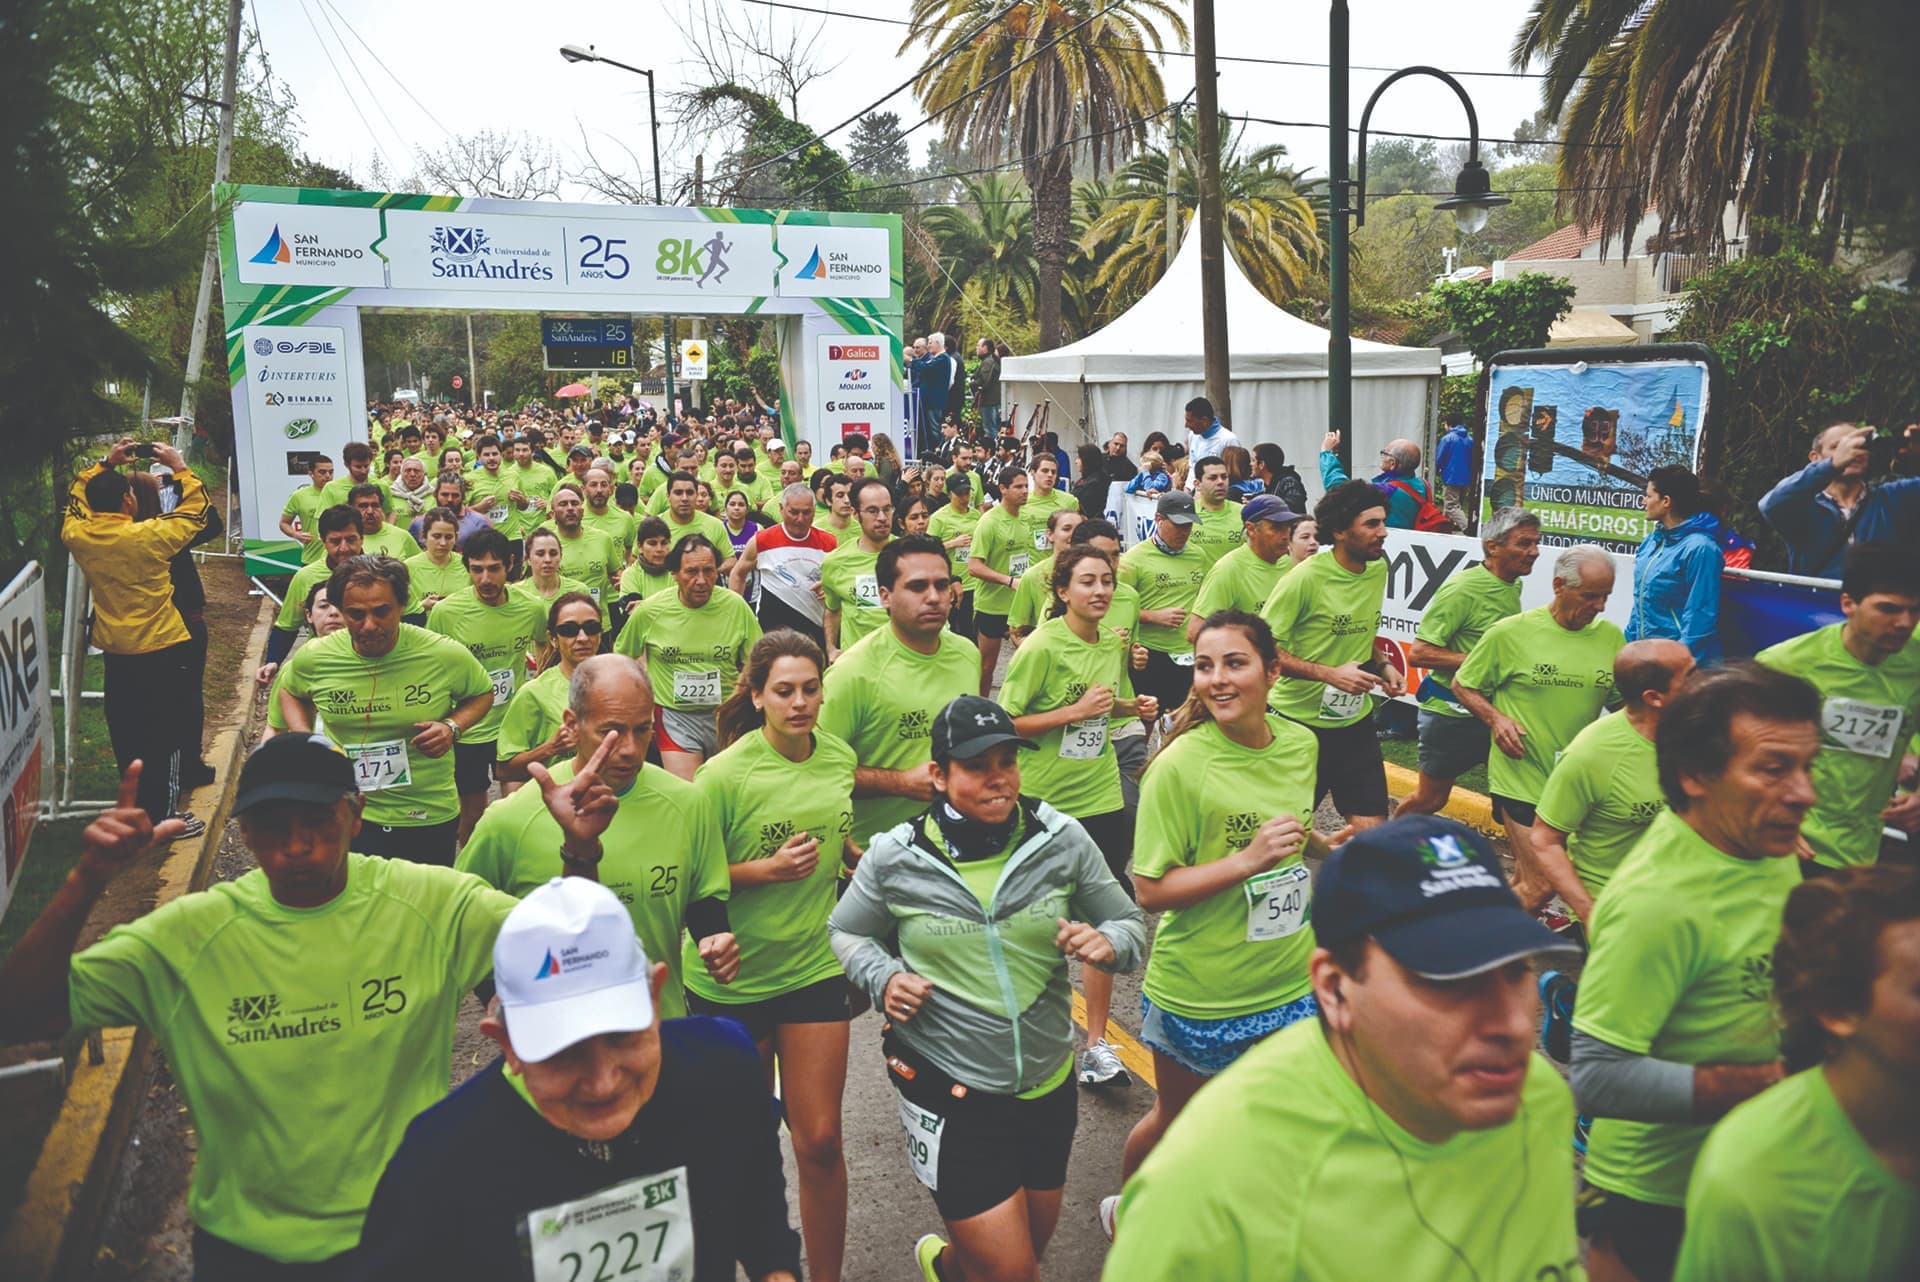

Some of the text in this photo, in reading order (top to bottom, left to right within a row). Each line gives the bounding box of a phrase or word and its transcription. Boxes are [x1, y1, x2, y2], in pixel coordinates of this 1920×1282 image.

[294, 233, 319, 244] SAN
[295, 246, 363, 259] FERNANDO
[494, 247, 540, 257] Universidad
[579, 234, 630, 280] 25
[829, 252, 848, 261] SAN
[295, 259, 336, 267] MUNICIPIO
[432, 257, 553, 281] SanAndrés
[829, 263, 882, 274] FERNANDO
[580, 271, 604, 279] AÑOS
[606, 323, 626, 341] 25
[847, 348, 876, 358] Galicia
[271, 372, 336, 381] INTERTURIS
[838, 402, 885, 411] GATORADE
[1530, 485, 1573, 503] ÚNICO
[713, 645, 731, 660] 25
[404, 683, 432, 705] 25
[680, 684, 715, 697] 2222
[1829, 714, 1889, 738] 2174
[1076, 730, 1103, 748] 539
[358, 760, 395, 779] 171
[650, 865, 679, 896] 25
[1268, 889, 1300, 920] 540
[361, 975, 407, 1015] 25
[226, 1014, 341, 1046] SanAndrés
[650, 1182, 672, 1204] 3K
[559, 1220, 669, 1282] 2227
